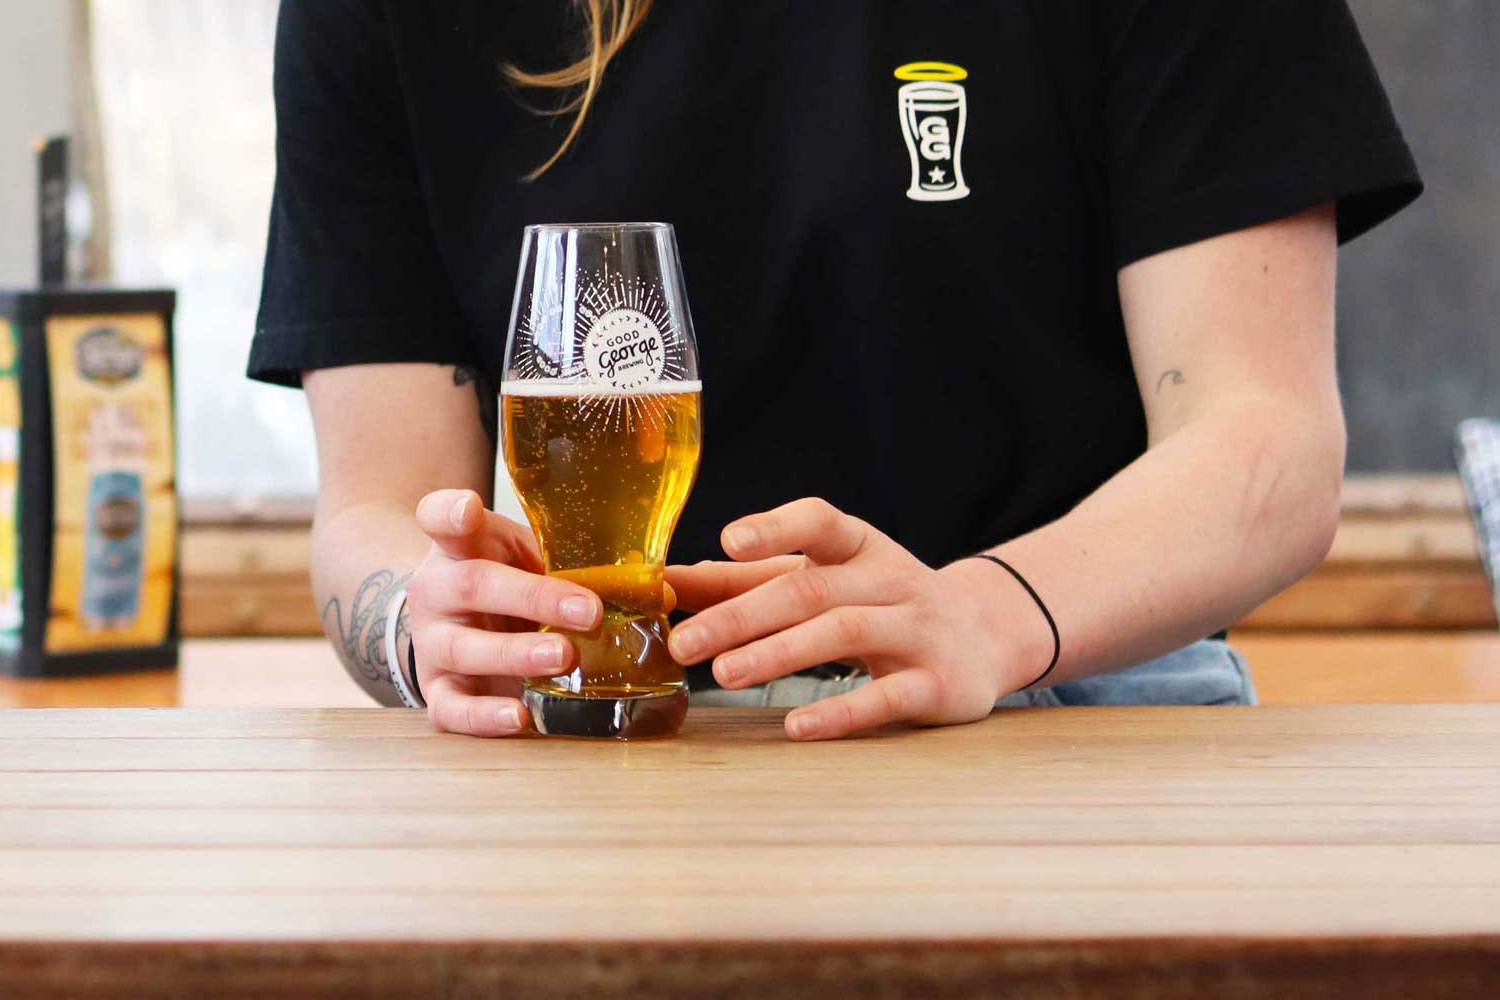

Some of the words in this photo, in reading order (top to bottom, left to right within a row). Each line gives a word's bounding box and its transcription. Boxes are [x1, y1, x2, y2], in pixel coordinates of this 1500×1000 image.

[606, 330, 640, 347] GOOD
[598, 337, 659, 378] George
[617, 358, 645, 372] BREWING
